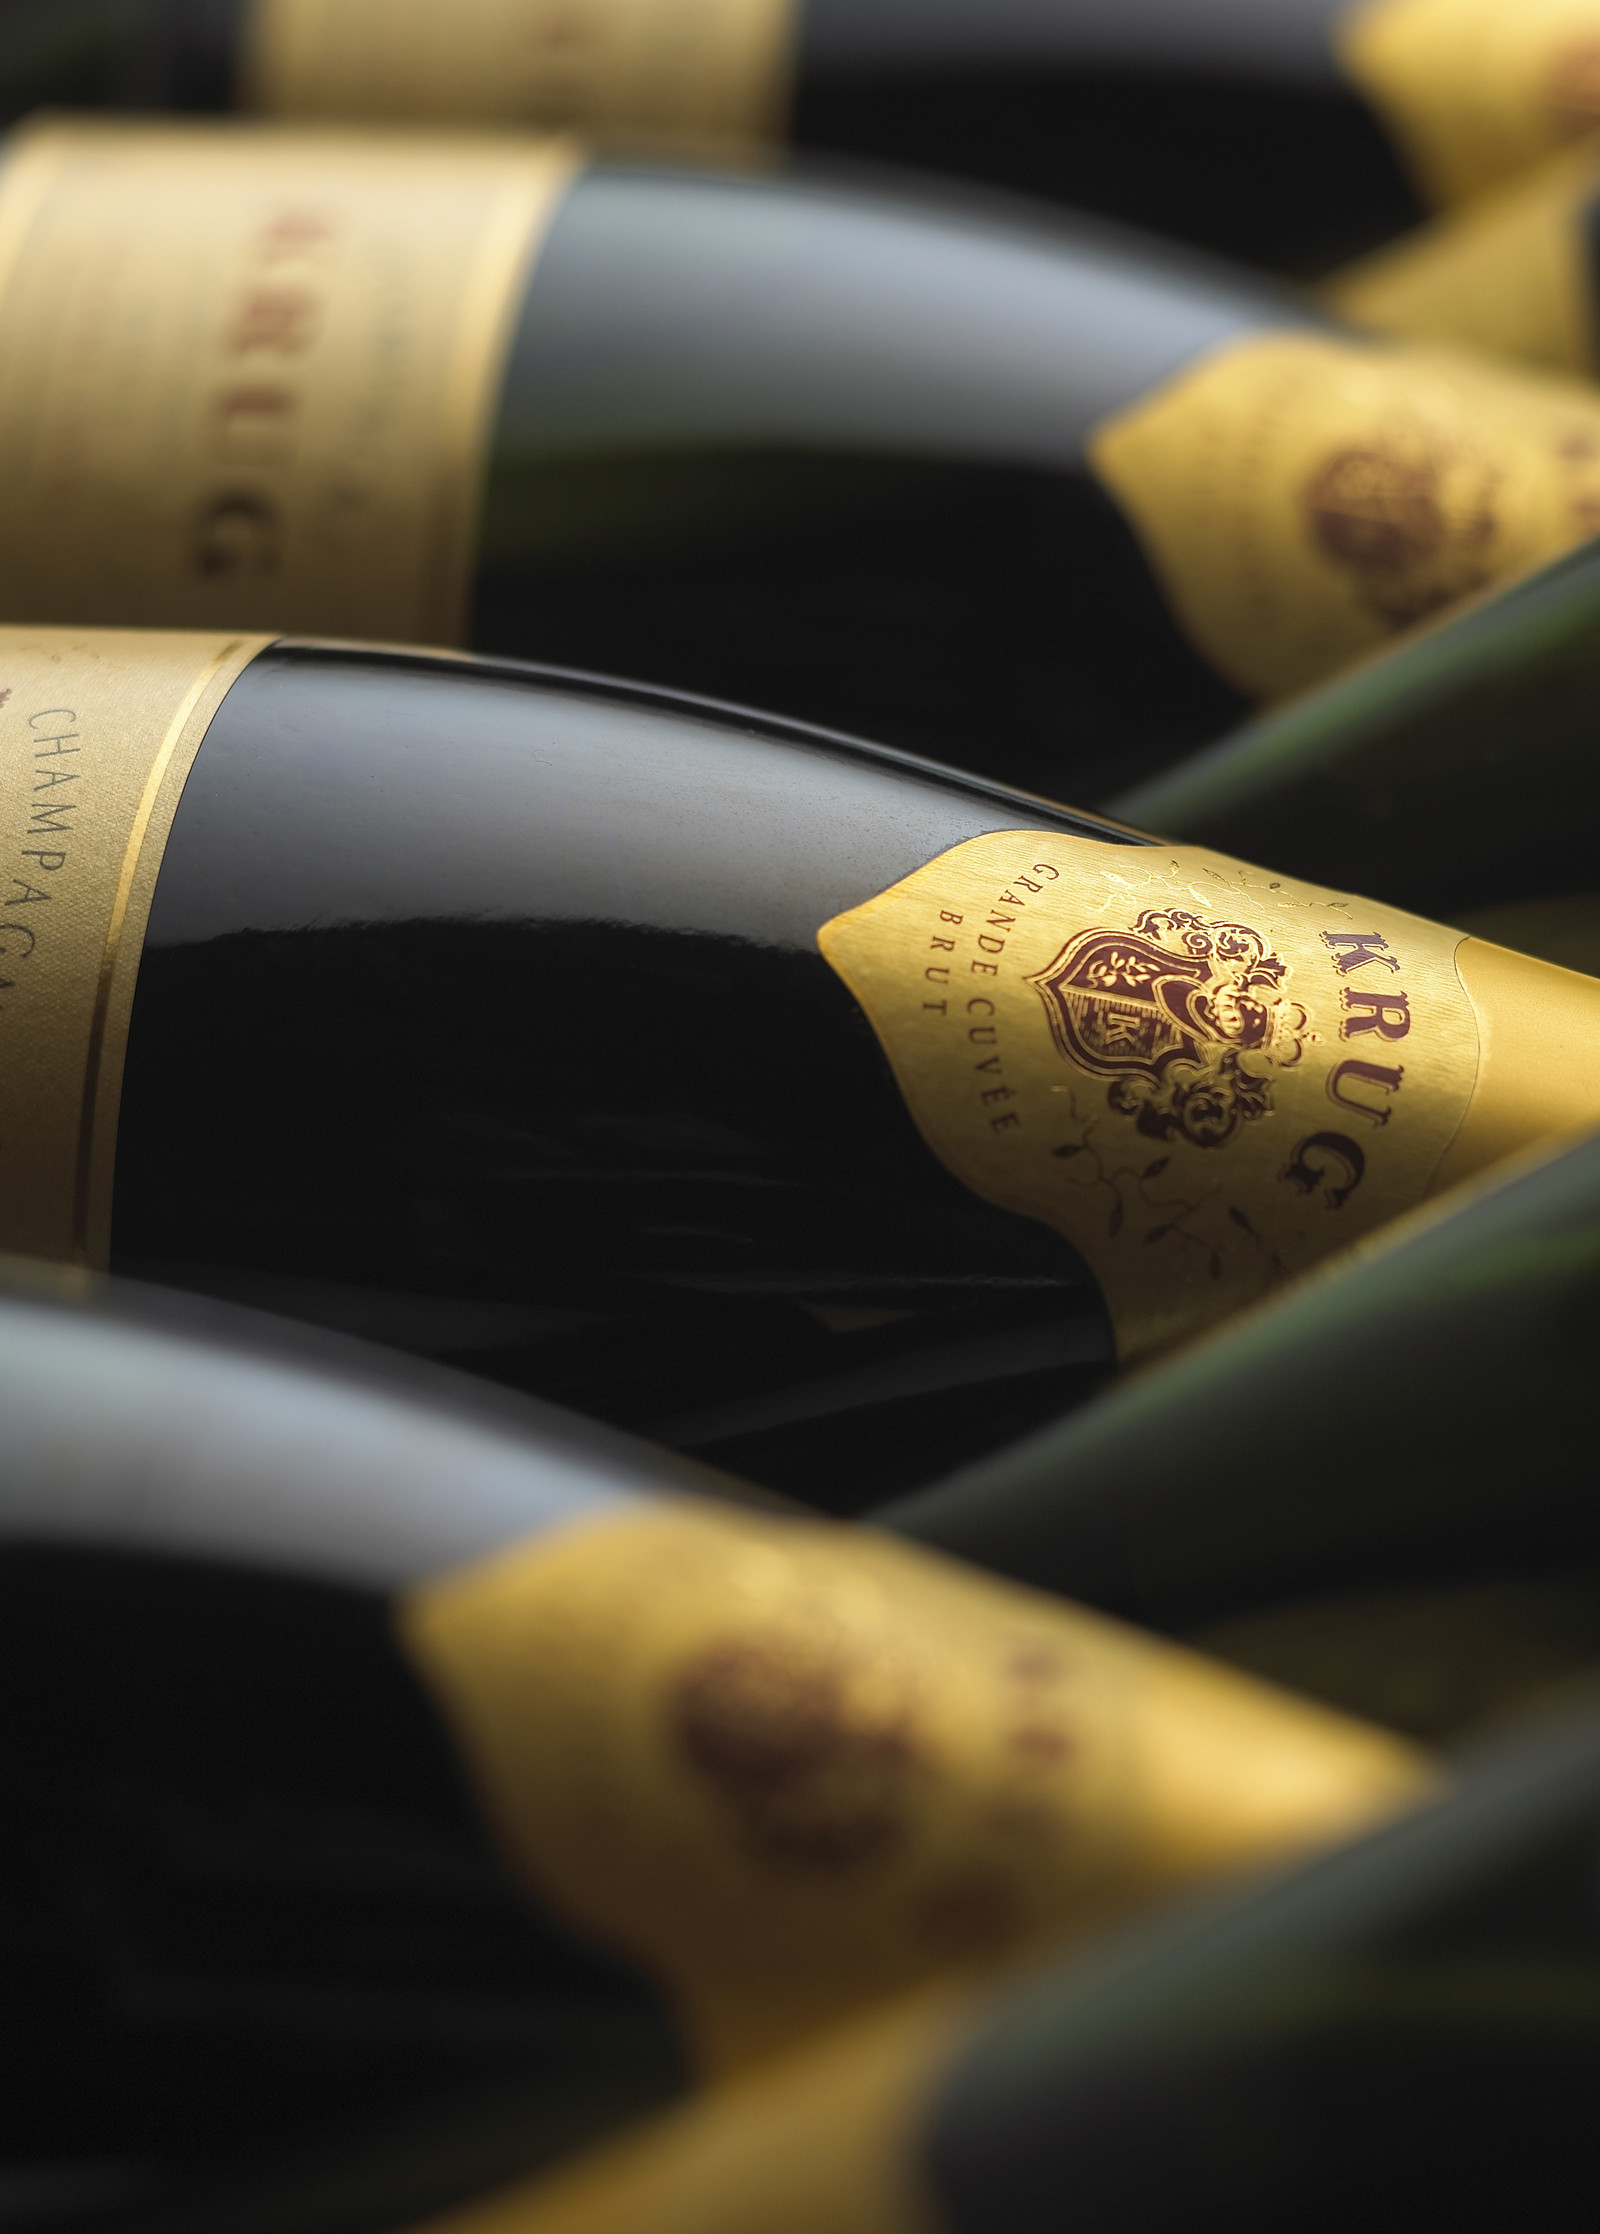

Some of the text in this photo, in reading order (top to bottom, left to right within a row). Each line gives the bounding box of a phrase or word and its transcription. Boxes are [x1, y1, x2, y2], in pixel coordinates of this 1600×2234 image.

[922, 909, 964, 1016] BRUT
[966, 862, 1061, 1134] GRANDE CUVÉE
[1276, 930, 1411, 1210] KRUG
